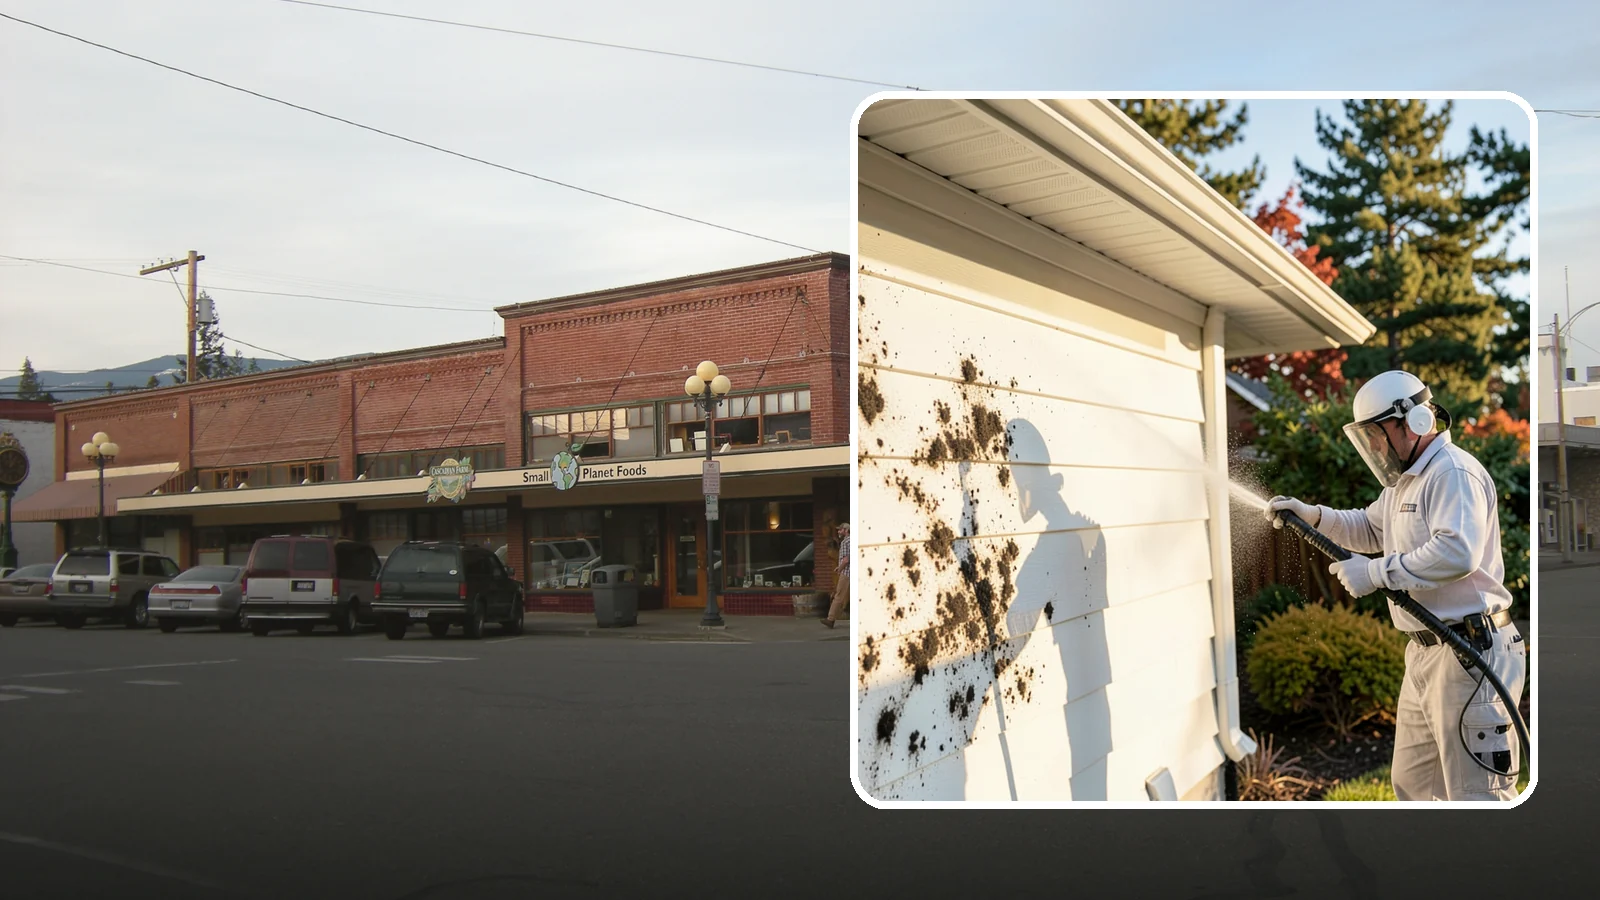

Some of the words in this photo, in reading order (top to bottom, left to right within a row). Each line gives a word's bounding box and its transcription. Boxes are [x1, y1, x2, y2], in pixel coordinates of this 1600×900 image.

[523, 471, 549, 483] Small
[583, 467, 614, 479] Planet
[616, 464, 647, 477] Foods
